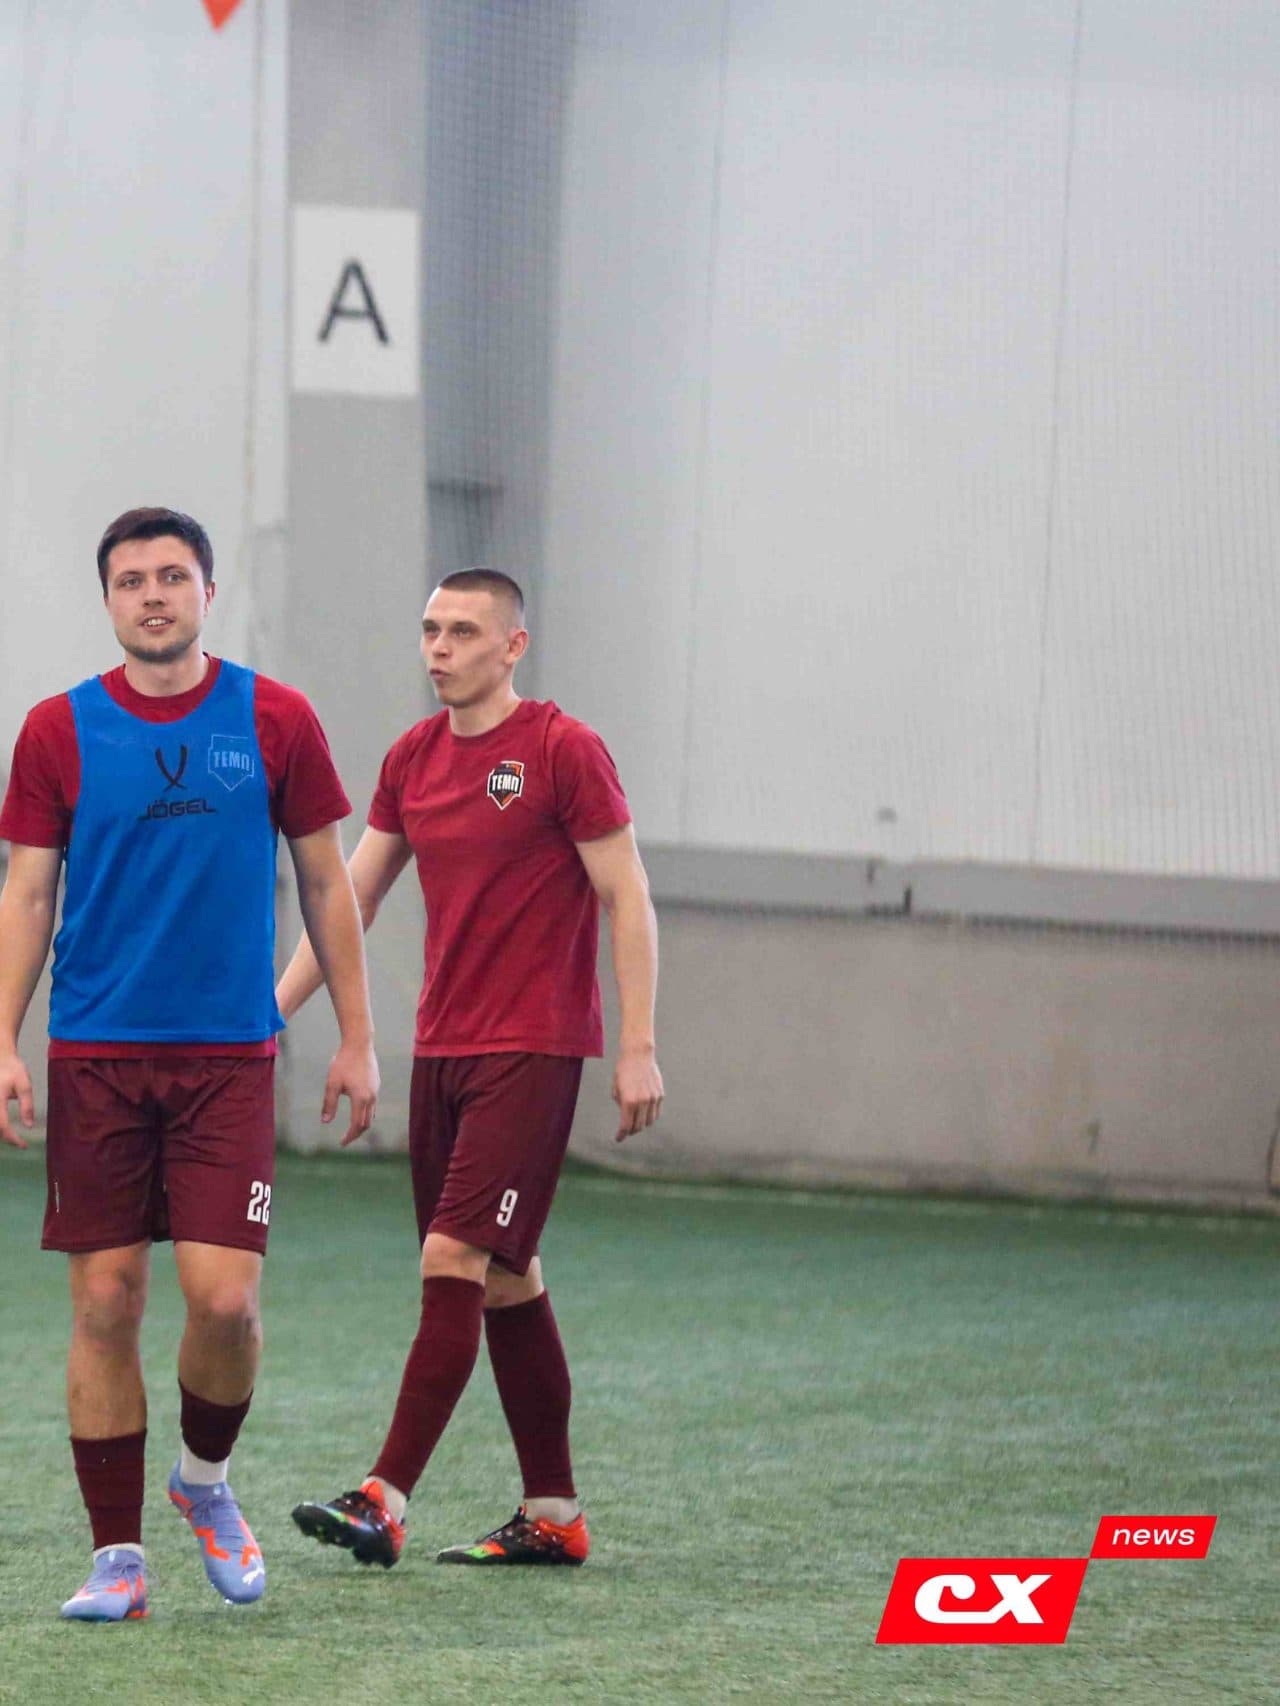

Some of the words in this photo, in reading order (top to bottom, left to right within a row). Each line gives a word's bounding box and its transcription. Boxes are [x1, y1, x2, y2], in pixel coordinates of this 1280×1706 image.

[319, 258, 389, 346] A
[247, 1180, 272, 1226] 22
[496, 1188, 518, 1228] 9
